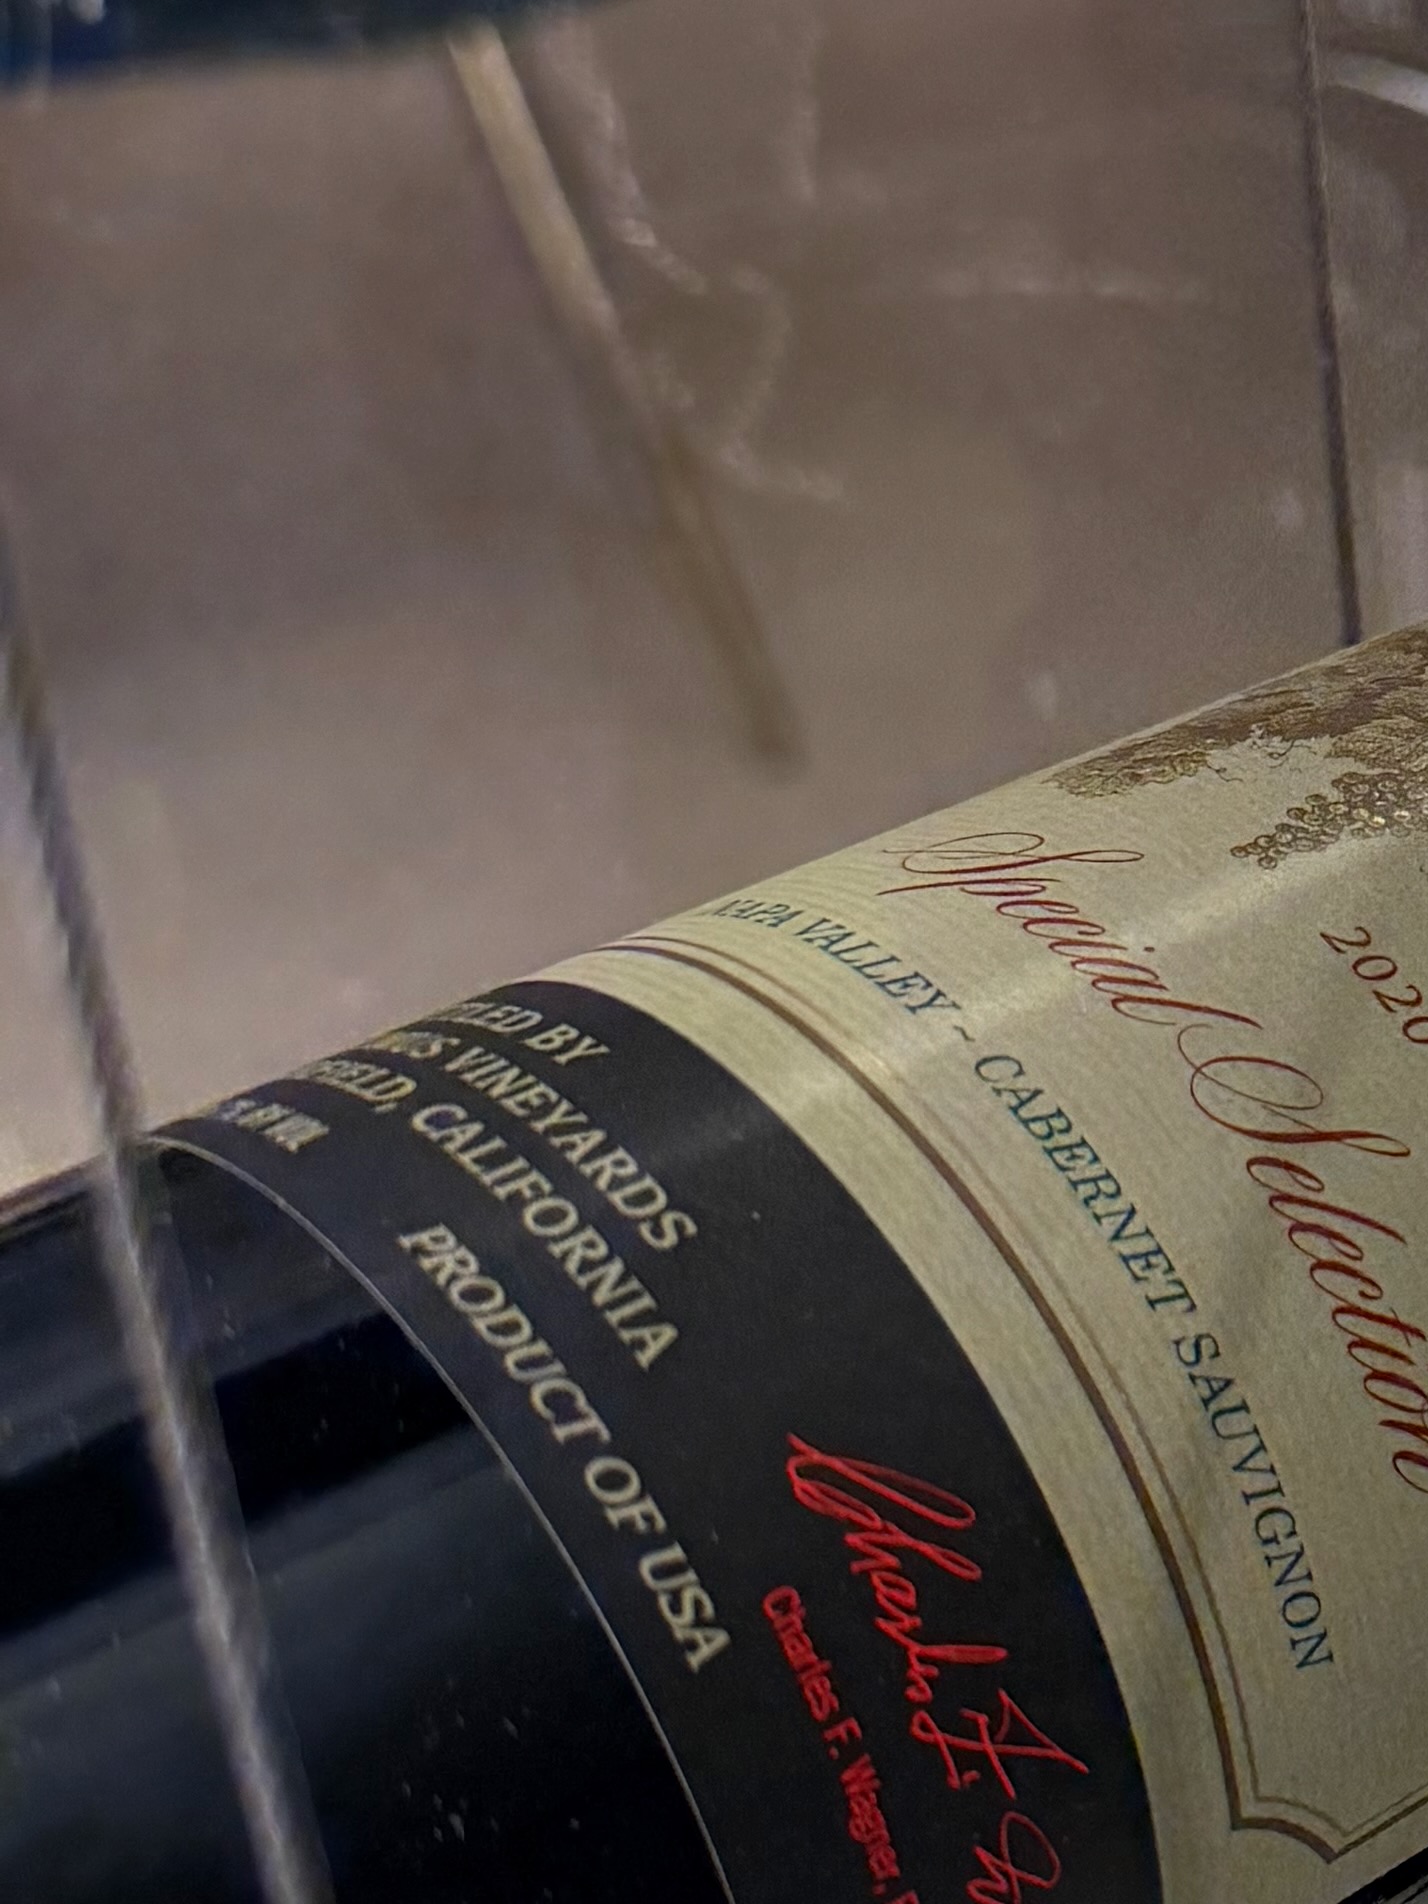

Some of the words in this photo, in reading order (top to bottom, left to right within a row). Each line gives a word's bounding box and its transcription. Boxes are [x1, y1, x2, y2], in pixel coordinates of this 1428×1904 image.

[876, 832, 1262, 1029] Special
[525, 1022, 610, 1066] BY
[411, 1102, 680, 1372] CALIFORNIA
[444, 1046, 699, 1250] VINEYARDS
[711, 898, 800, 929] NAPA
[794, 917, 962, 1016] VALLEY
[974, 1053, 1197, 1316] CABERNET
[1173, 1332, 1334, 1670] SAUVIGNON
[397, 1222, 608, 1450] PRODUCT
[583, 1452, 667, 1534] OF
[636, 1537, 734, 1676] USA
[762, 1586, 841, 1723] Charles
[822, 1717, 863, 1760] F.
